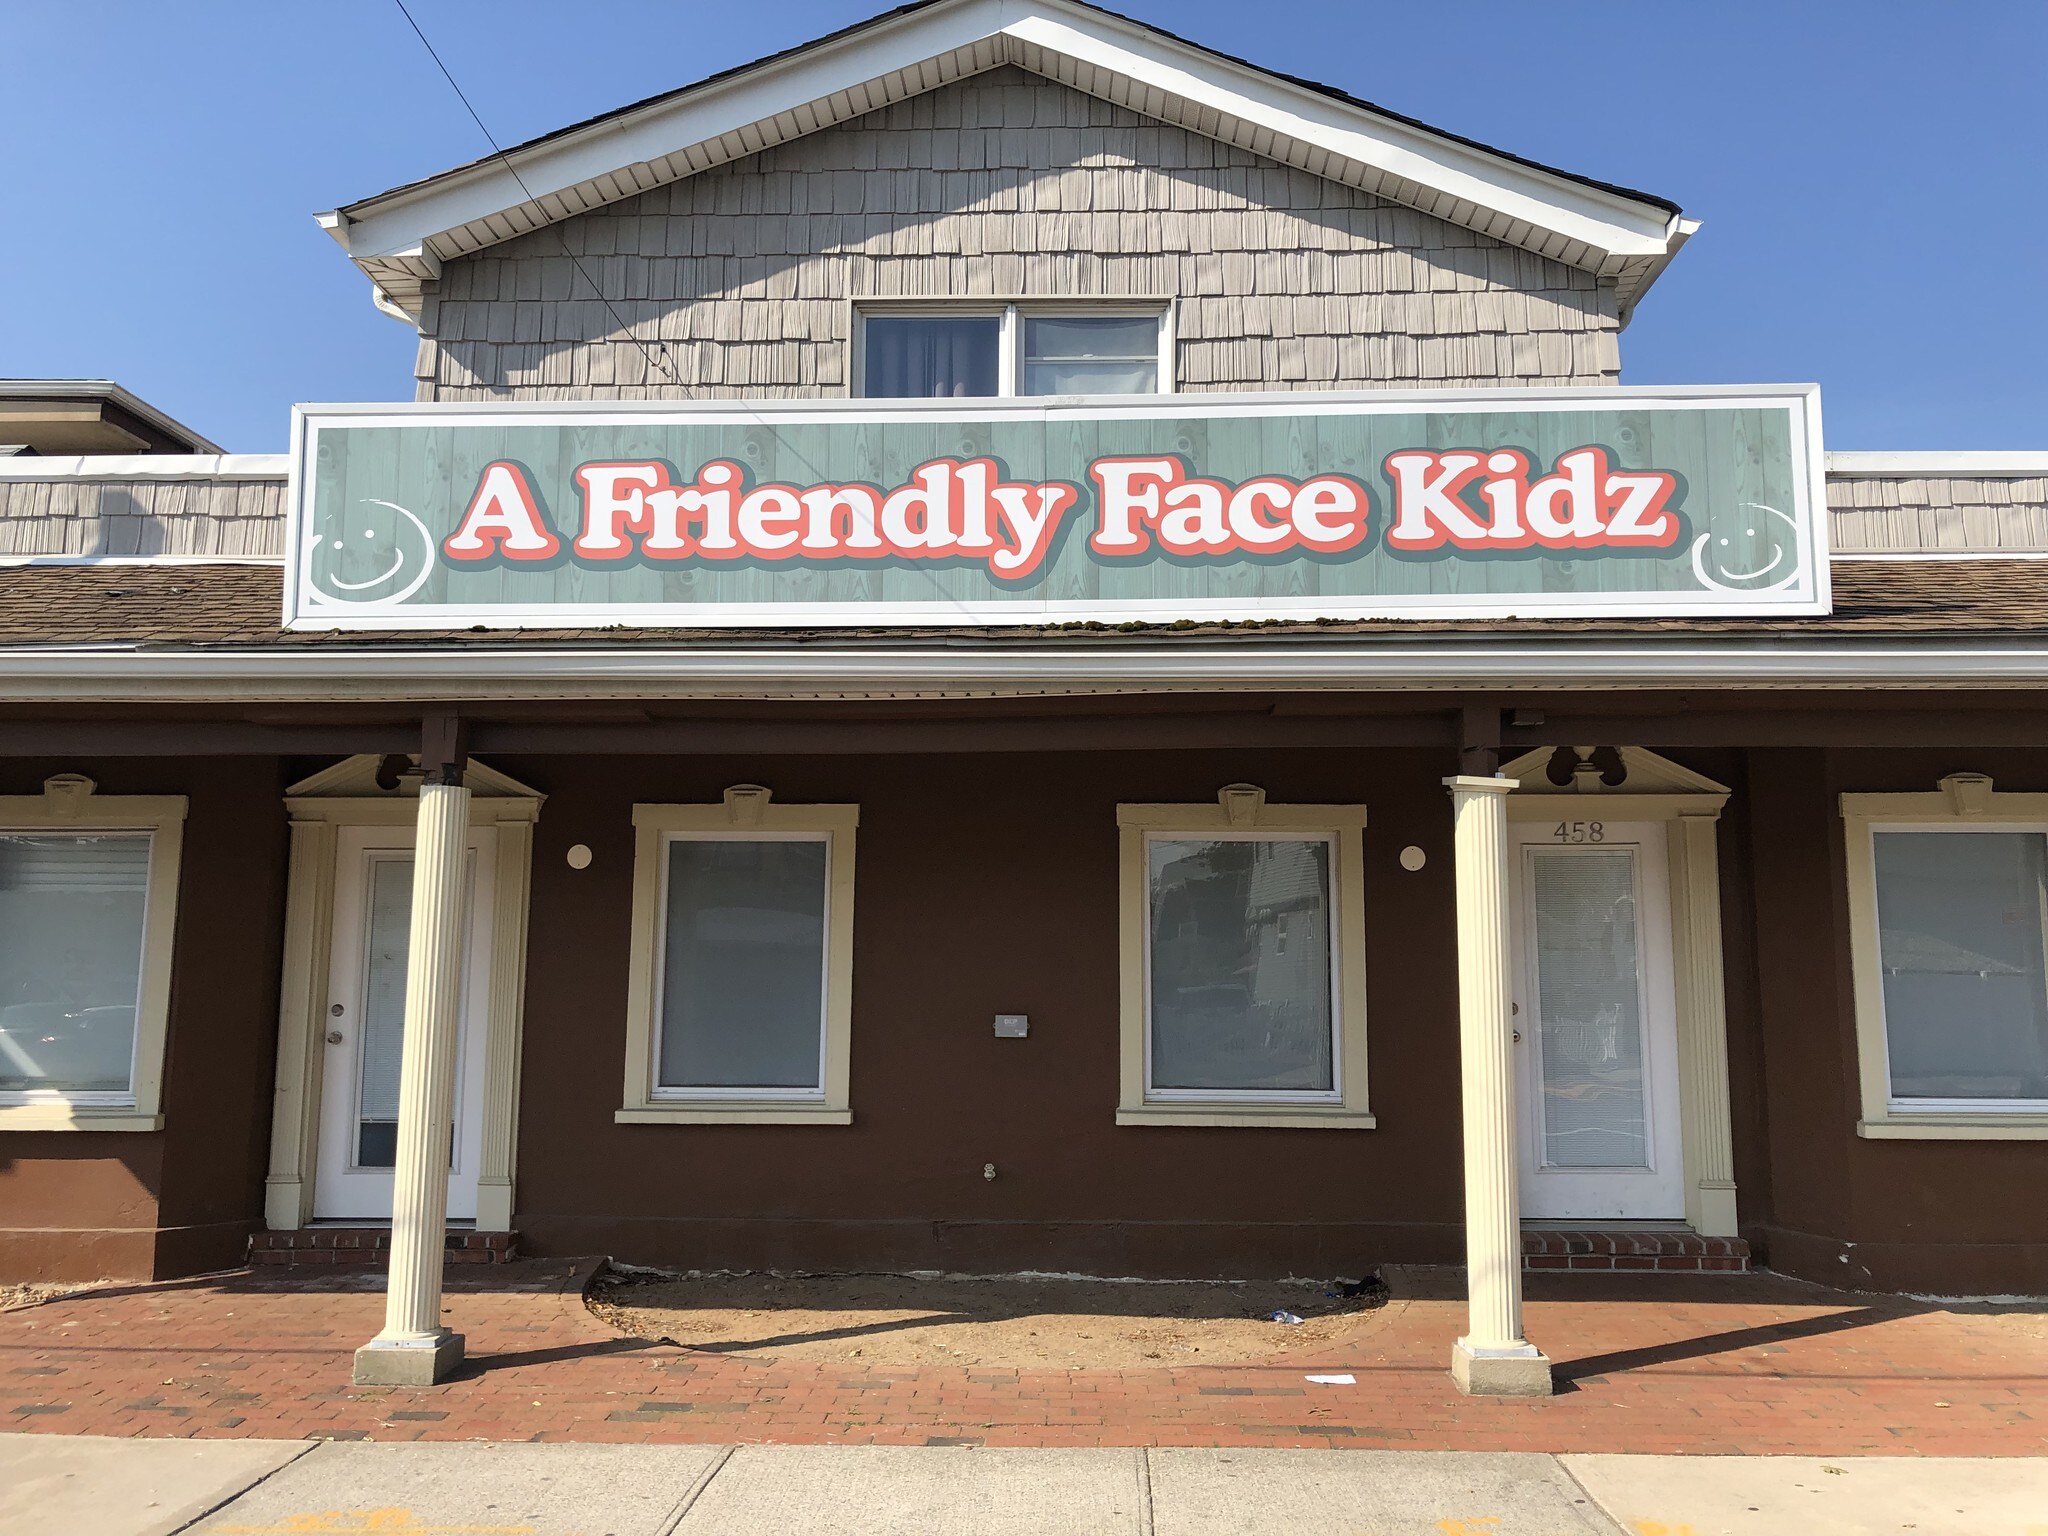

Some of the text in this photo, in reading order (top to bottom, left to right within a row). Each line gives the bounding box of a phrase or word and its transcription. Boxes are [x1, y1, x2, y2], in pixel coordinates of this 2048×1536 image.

[448, 450, 1668, 570] A Friendly Face Kidz
[1553, 821, 1605, 843] 458
